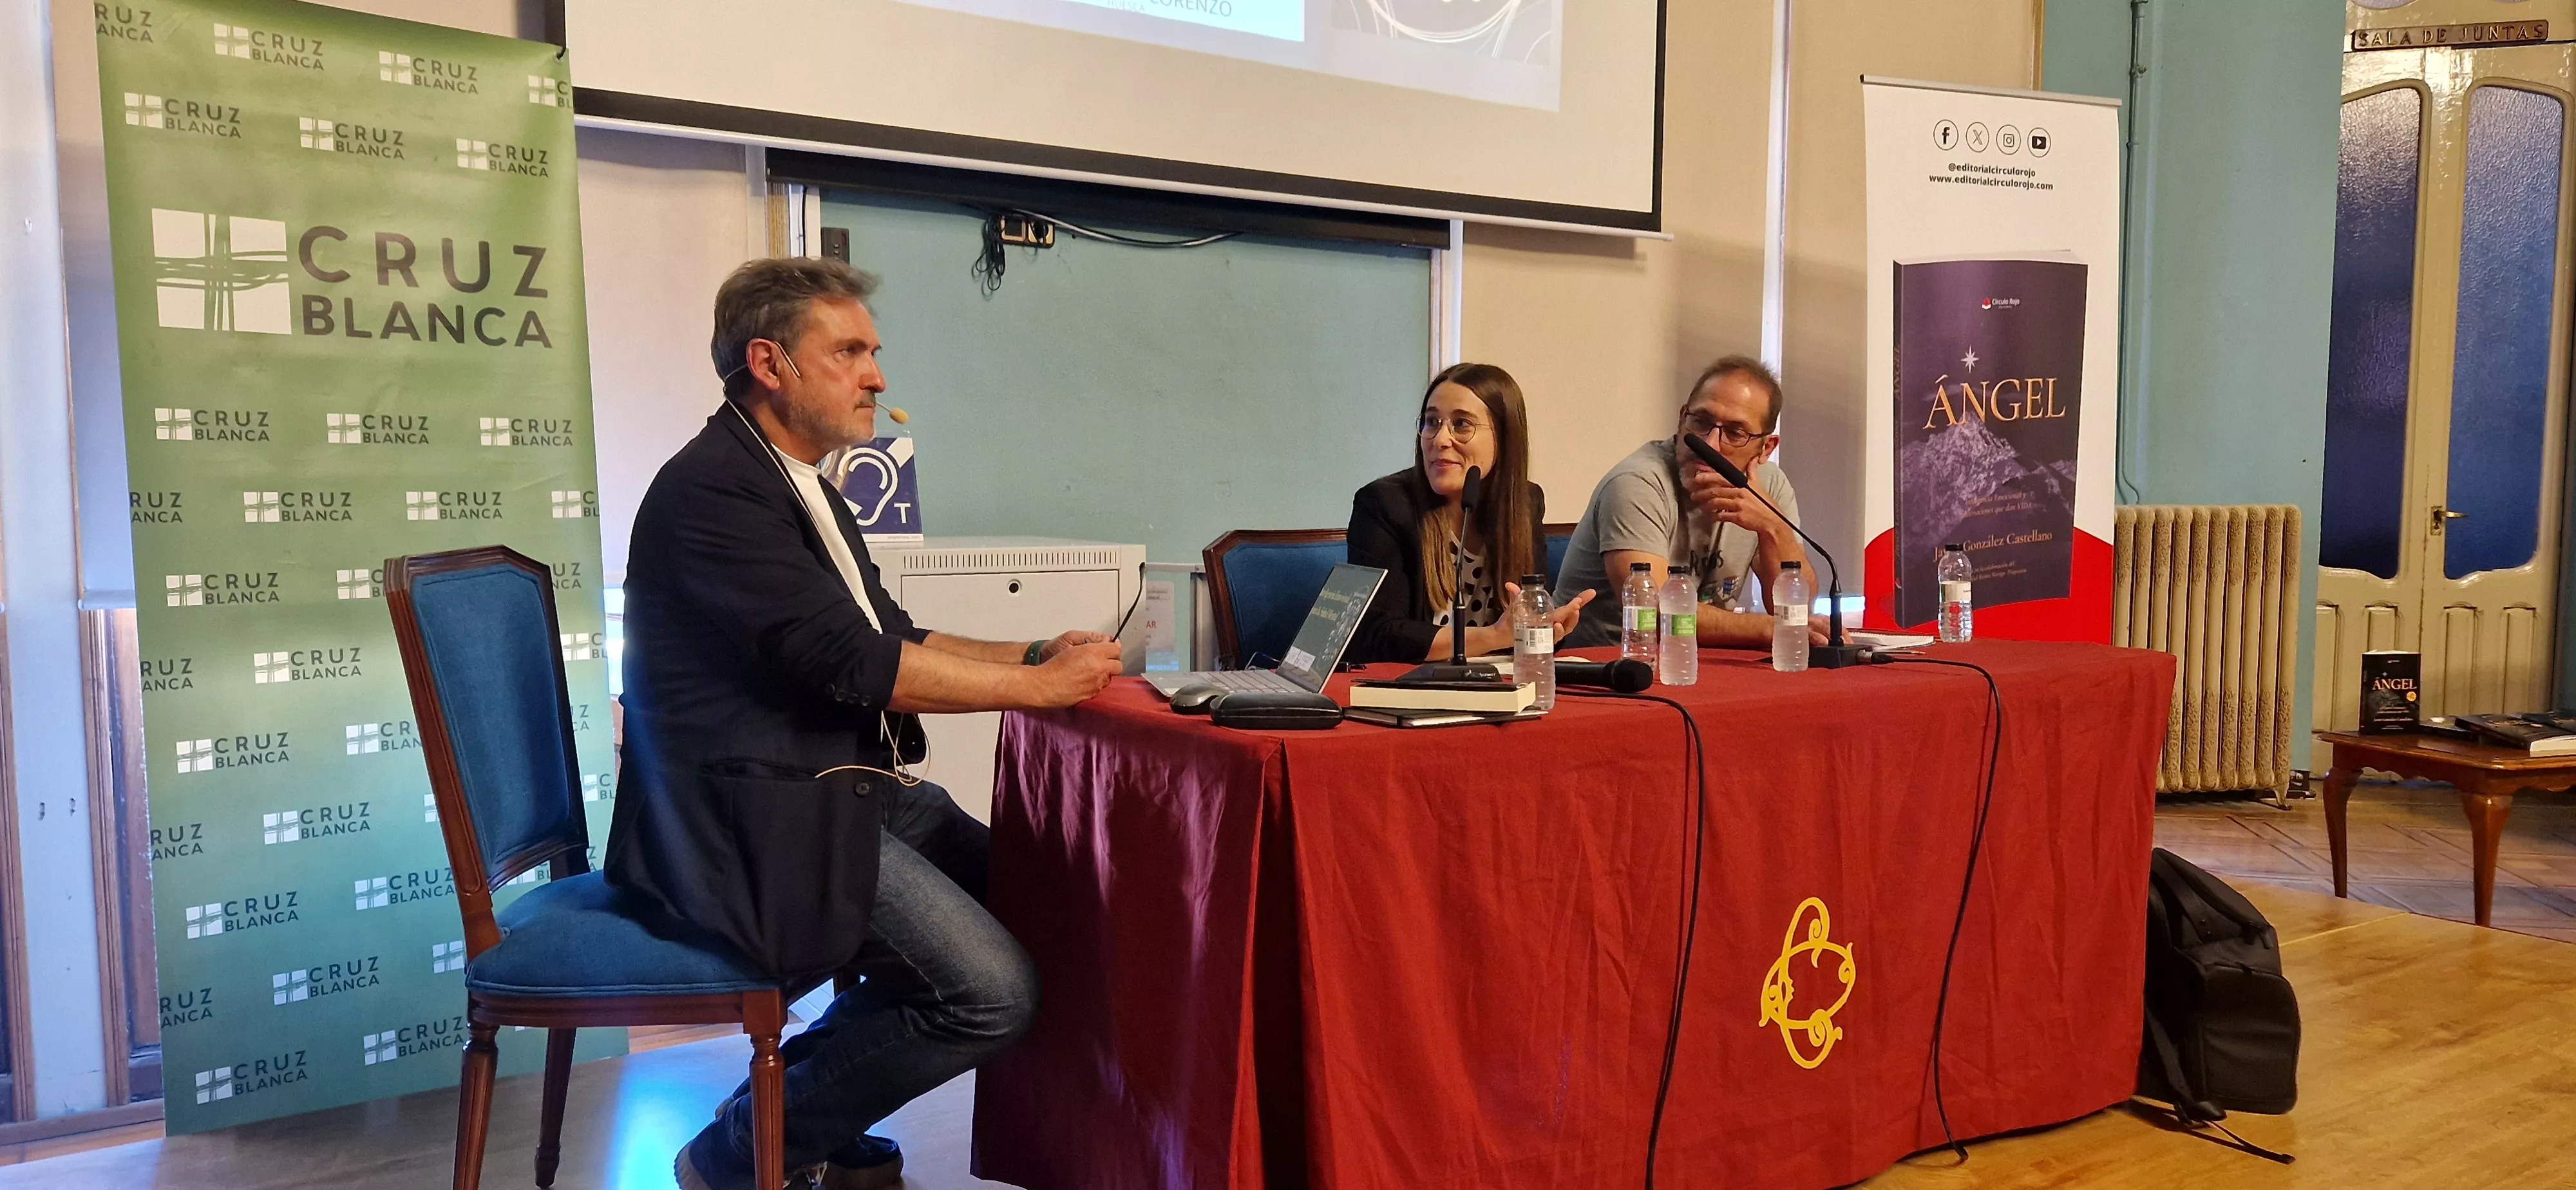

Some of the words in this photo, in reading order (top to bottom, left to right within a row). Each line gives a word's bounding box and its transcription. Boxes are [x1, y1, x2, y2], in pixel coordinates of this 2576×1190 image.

[94, 3, 152, 27] RUZ
[1151, 0, 1231, 17] RENZO
[96, 23, 153, 43] ANCA
[2359, 31, 2412, 46] SALA
[2423, 28, 2447, 44] DE
[2461, 24, 2543, 41] JUNTAS
[251, 31, 323, 57] CRUZ
[252, 48, 324, 71] BLANCA
[412, 57, 477, 82] CRUZ
[413, 74, 478, 95] BLANCA
[165, 99, 240, 123] CRUZ
[166, 118, 241, 138] BLANCA
[336, 122, 404, 146] CRUZ
[336, 140, 404, 160] BLANCA
[489, 143, 549, 164] CRUZ
[489, 160, 549, 178] BLANCA
[1948, 162, 2036, 178] @editorialcirculorojo
[1929, 175, 2054, 191] www.editorialcirculorojo.com
[298, 225, 547, 298] CRUZ
[303, 294, 552, 348] BLANCA
[1923, 374, 2066, 430] ÁNGEL
[194, 410, 270, 428] CRUZ
[362, 415, 428, 431] CRUZ
[511, 418, 572, 433] CRUZ
[195, 429, 270, 442] BLANCA
[363, 432, 429, 444] BLANCA
[511, 435, 573, 446] BLANCA
[129, 492, 182, 508] RUZ
[281, 492, 352, 507] CRUZ
[439, 491, 502, 506] CRUZ
[131, 511, 183, 524] ANCA
[281, 509, 352, 522] BLANCA
[439, 507, 502, 520] BLANCA
[893, 503, 911, 524] T
[1963, 534, 2003, 552] González
[2007, 529, 2052, 545] Castellano
[553, 563, 581, 576] UZ
[204, 572, 278, 590] CRUZ
[553, 579, 582, 589] NCA
[205, 590, 279, 605] BLANCA
[140, 658, 193, 676] RUZ
[290, 648, 361, 666] CRUZ
[291, 665, 361, 681] BLANCA
[142, 677, 193, 692] ANCA
[2372, 677, 2417, 690] ÁNGEL
[381, 721, 410, 737] CR
[214, 733, 289, 753] CRUZ
[381, 738, 421, 751] BLAN
[215, 751, 290, 769] BLANCA
[300, 802, 370, 825] CRUZ
[151, 824, 202, 845] RUZ
[301, 820, 370, 839] BLANCA
[152, 842, 204, 861] ANCA
[389, 867, 453, 890] CRUZ
[224, 891, 297, 916] CRUZ
[390, 884, 455, 904] BLANCA
[225, 911, 298, 932] BLANCA
[308, 957, 379, 982] CRUZ
[310, 975, 379, 997] BLANCA
[160, 987, 213, 1014] RUZ
[161, 1006, 213, 1029] ANCA
[399, 1015, 463, 1043] CRUZ
[399, 1034, 464, 1057] BLANCA
[234, 1050, 306, 1079] CRUZ
[235, 1068, 307, 1095] BLANCA
